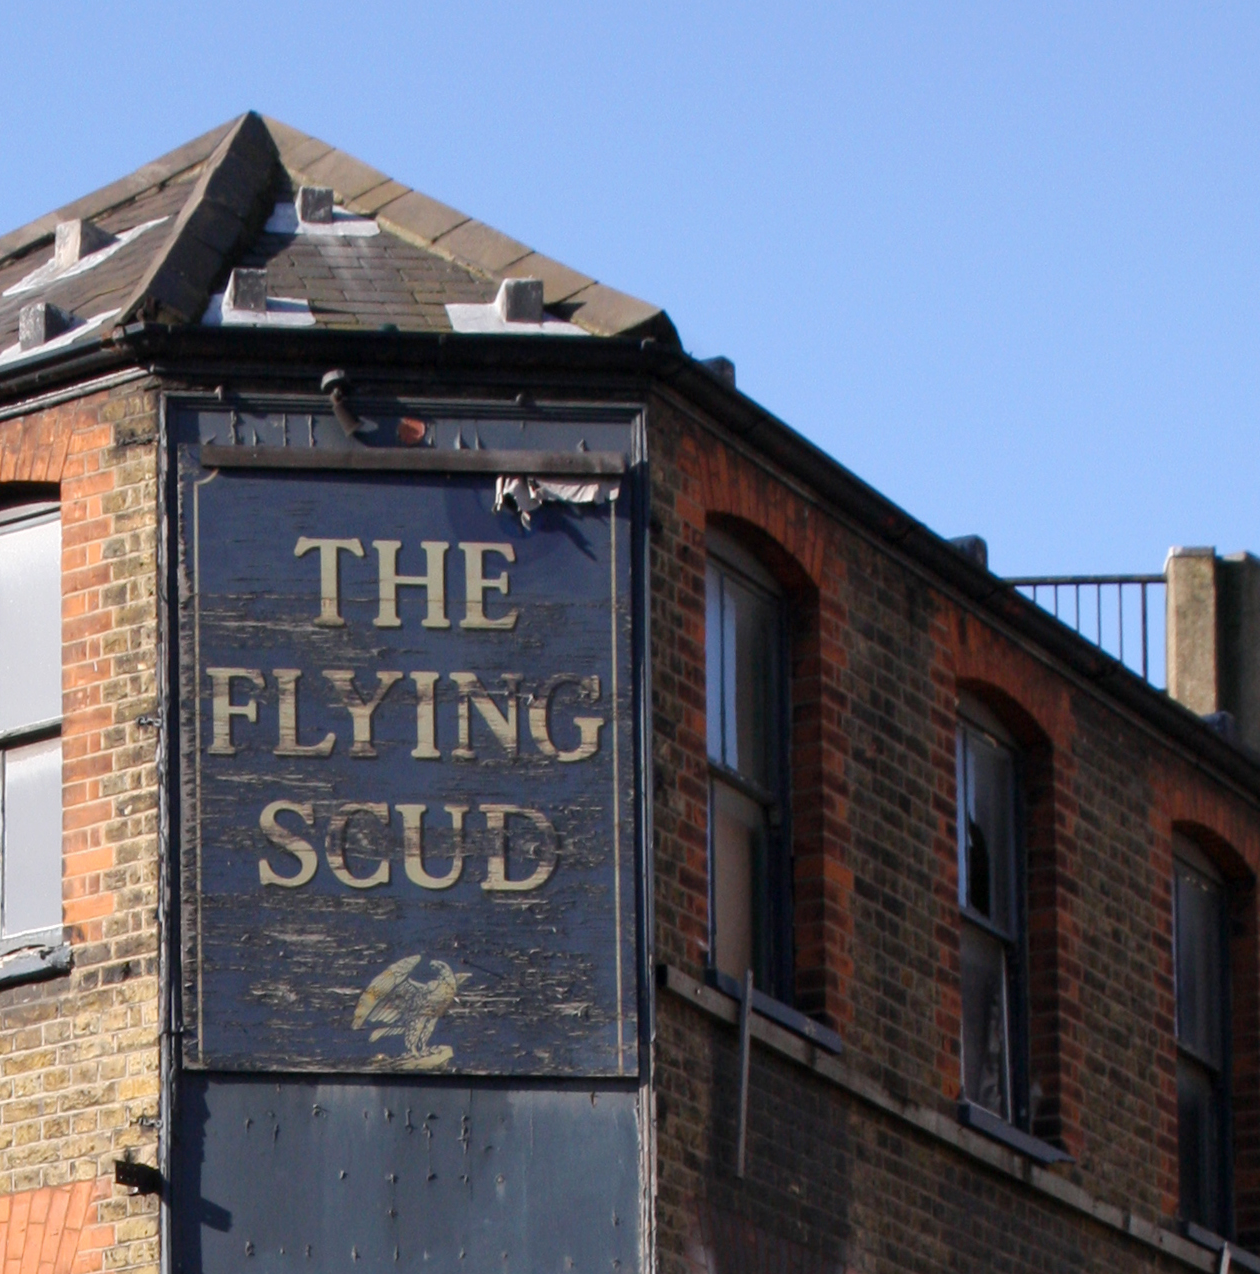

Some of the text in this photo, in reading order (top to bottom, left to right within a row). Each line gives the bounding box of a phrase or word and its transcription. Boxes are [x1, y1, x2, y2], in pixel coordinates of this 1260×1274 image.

[293, 536, 518, 630] THE
[206, 666, 605, 762] FLYING
[258, 799, 562, 892] SCUD
